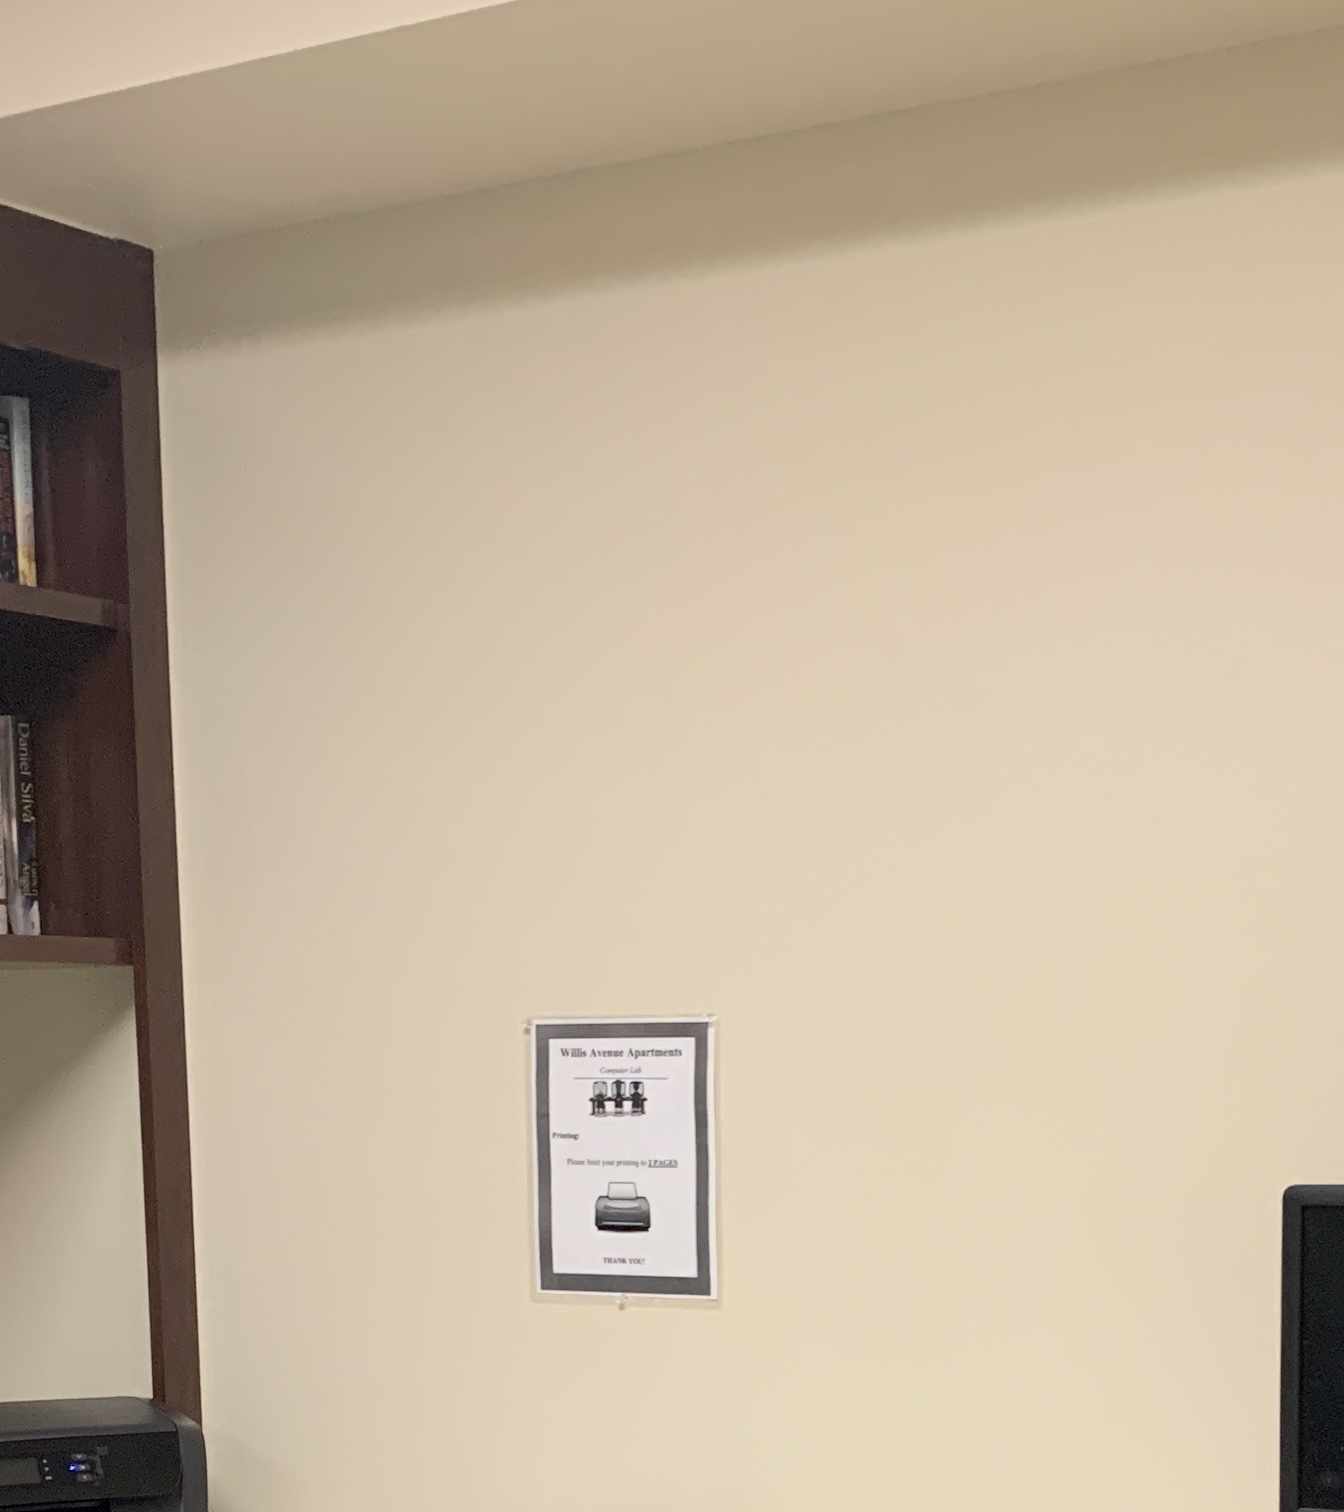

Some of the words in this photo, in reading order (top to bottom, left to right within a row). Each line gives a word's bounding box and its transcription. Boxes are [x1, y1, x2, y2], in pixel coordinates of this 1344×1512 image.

[17, 722, 33, 776] Daniel
[20, 781, 36, 823] Silva
[20, 861, 32, 897] Angel
[560, 1048, 587, 1058] Willis
[590, 1048, 624, 1058] Avenue
[627, 1048, 683, 1060] Apartments
[616, 1159, 640, 1168] printing
[603, 1256, 628, 1265] THANK
